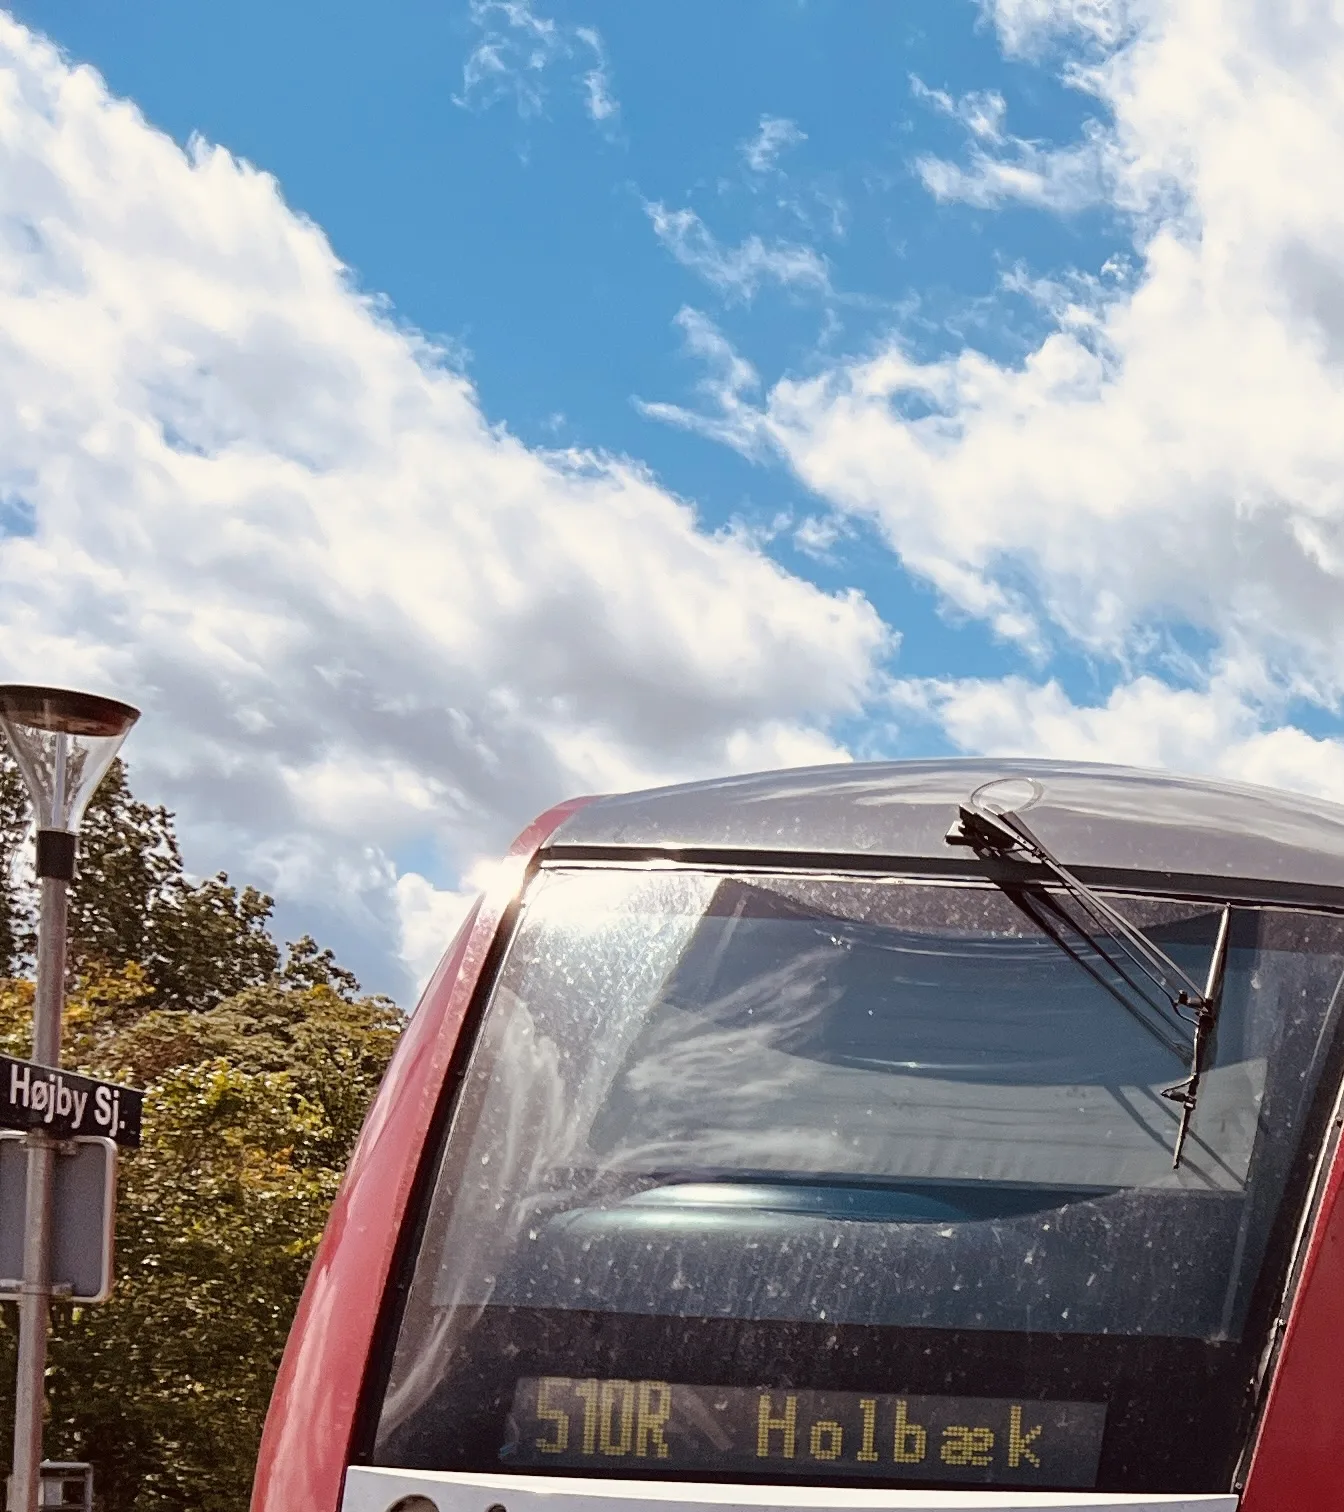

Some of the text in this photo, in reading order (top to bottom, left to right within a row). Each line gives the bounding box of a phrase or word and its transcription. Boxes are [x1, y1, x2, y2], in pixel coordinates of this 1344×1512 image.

[9, 1064, 126, 1137] Højby Sj.
[536, 1377, 1042, 1469] 510R Holbæk
